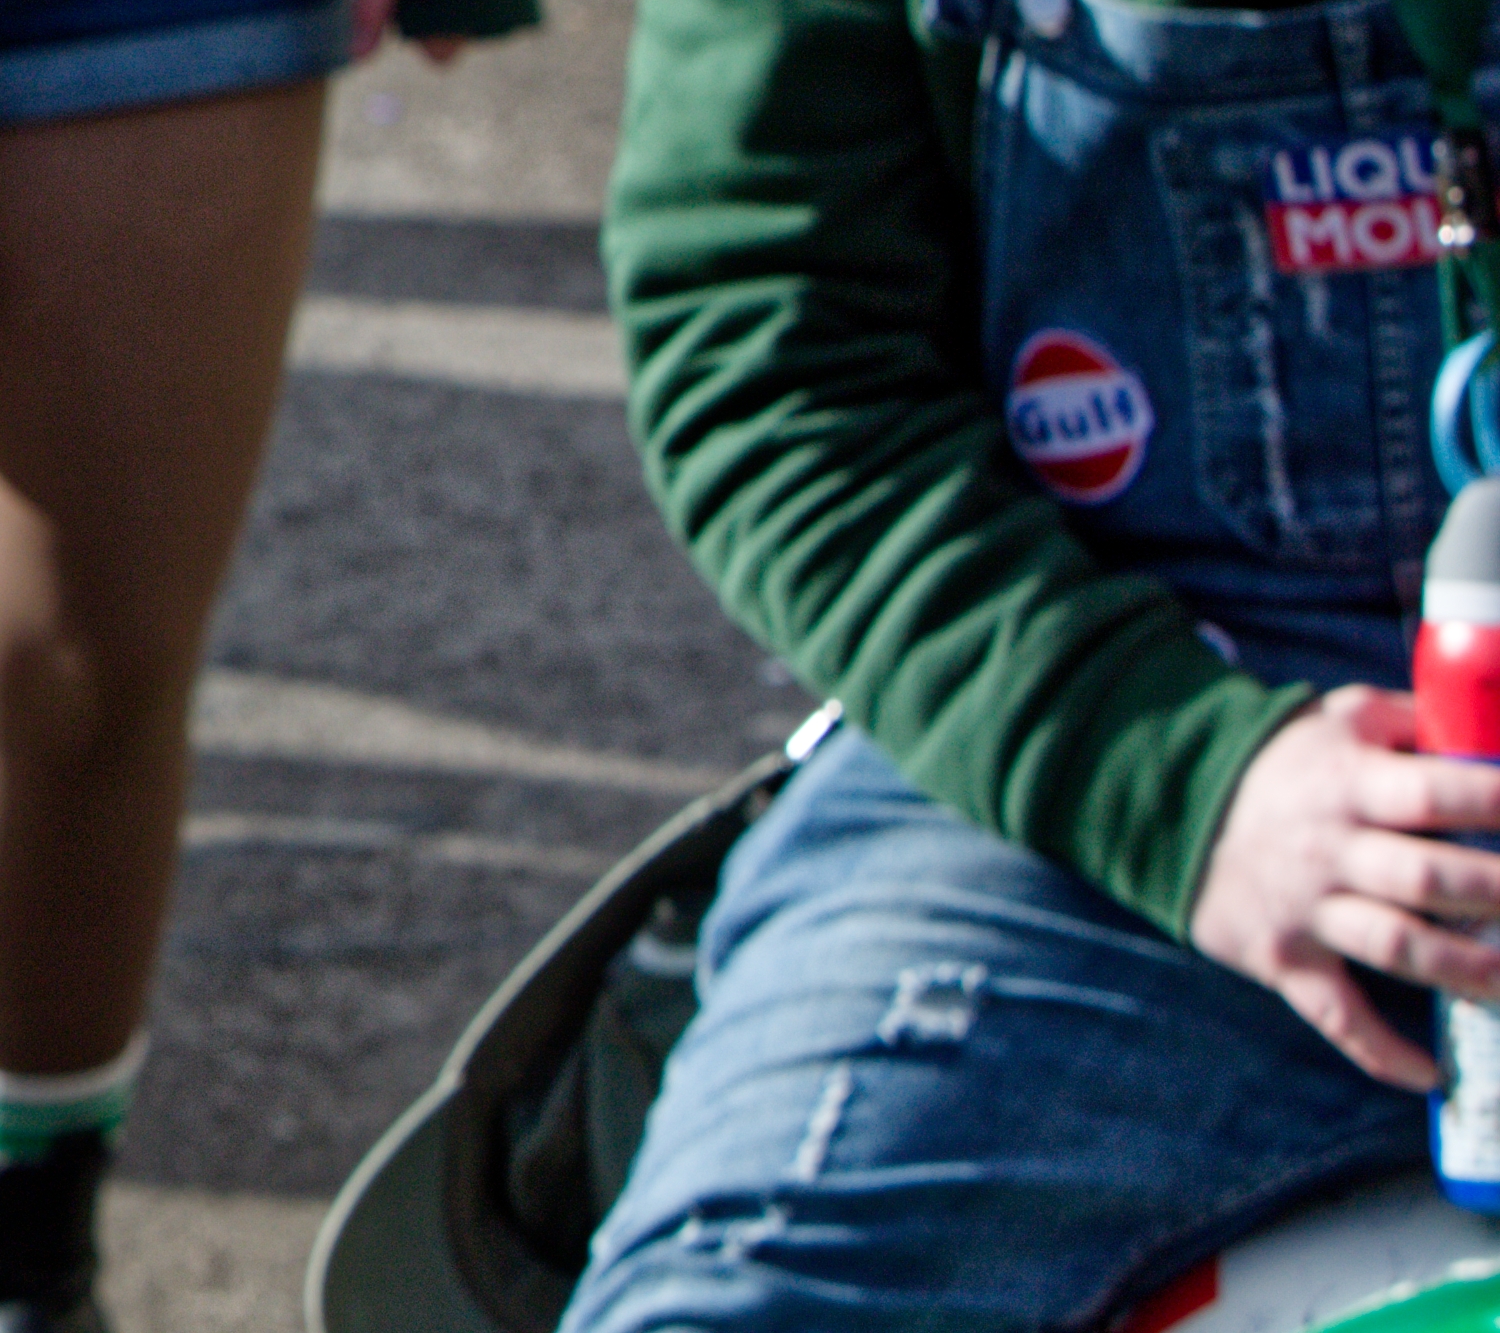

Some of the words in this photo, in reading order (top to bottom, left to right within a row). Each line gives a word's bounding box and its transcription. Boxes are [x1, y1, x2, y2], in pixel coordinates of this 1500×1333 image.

[1273, 137, 1446, 201] LIQU
[1285, 195, 1446, 264] MOL
[1013, 387, 1135, 445] Gulf
